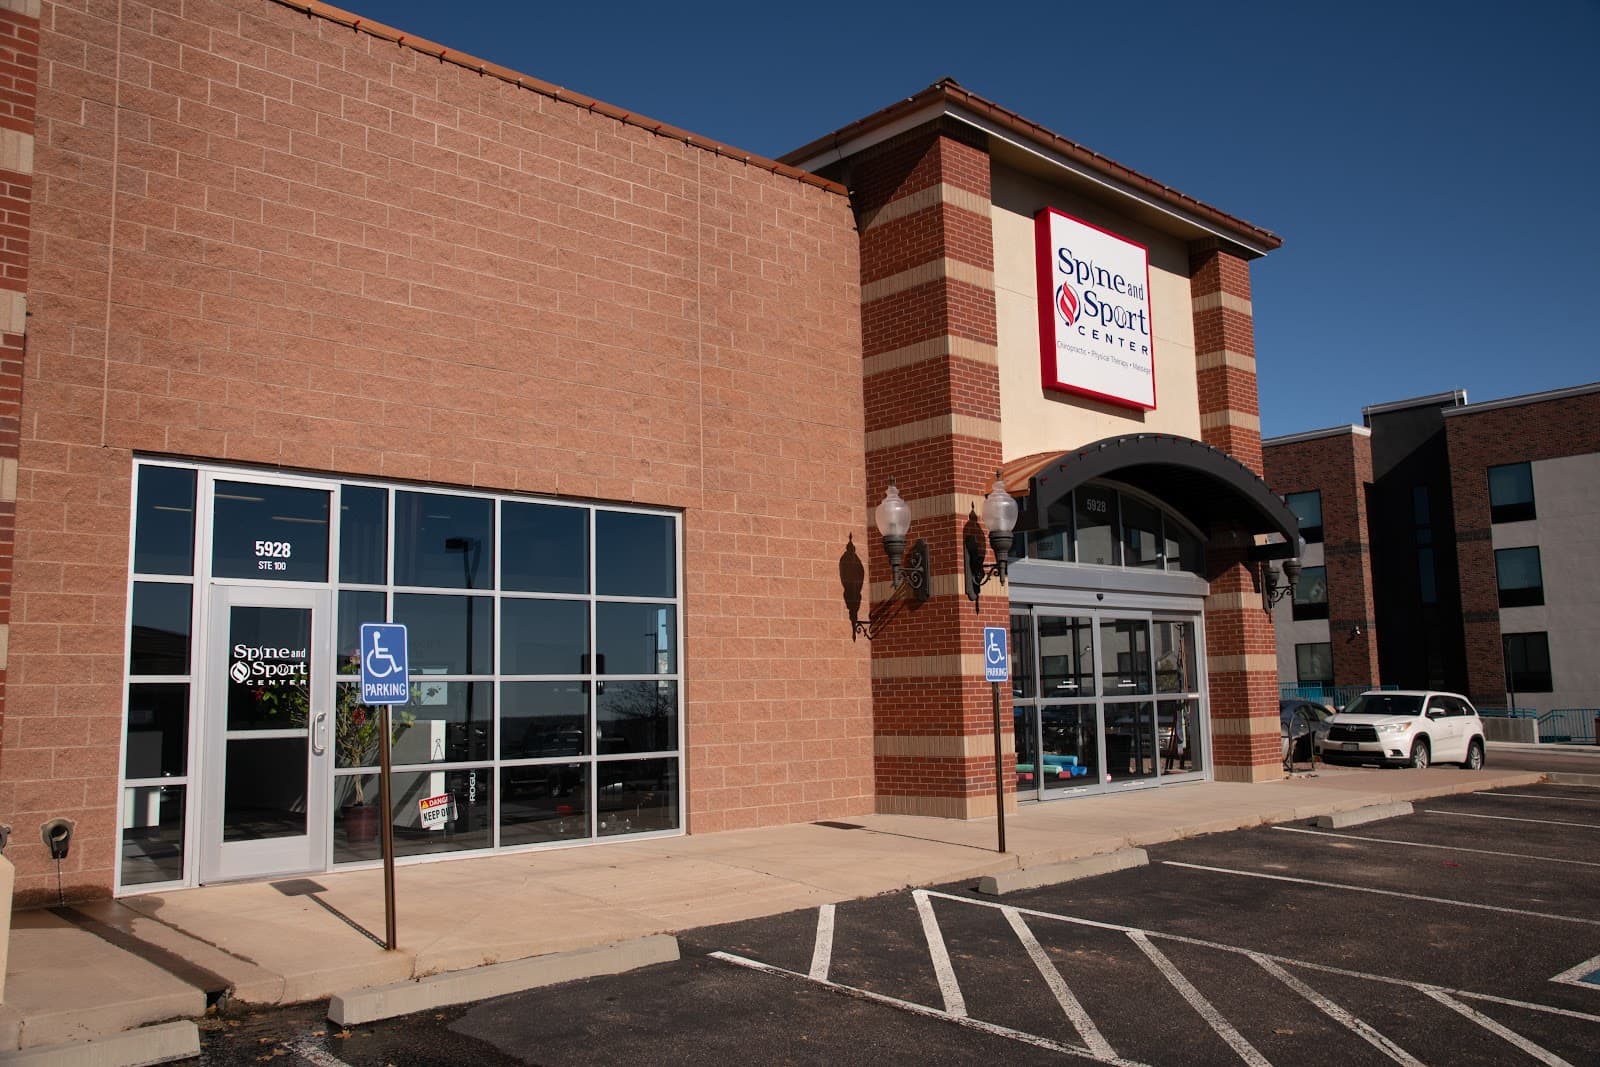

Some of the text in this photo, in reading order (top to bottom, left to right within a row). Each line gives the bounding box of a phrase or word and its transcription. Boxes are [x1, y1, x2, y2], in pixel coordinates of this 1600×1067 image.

[1058, 247, 1144, 301] Spine and
[1083, 290, 1149, 336] Sport
[1078, 325, 1149, 356] CENTER
[1087, 498, 1106, 513] 5928
[255, 540, 291, 558] 5928
[258, 560, 286, 571] STE 100
[234, 644, 306, 661] Spine and
[252, 661, 308, 678] Sport
[987, 667, 1007, 677] PARKING
[365, 683, 406, 697] PARKING
[469, 768, 477, 802] ROGU
[423, 809, 440, 822] KEEP
